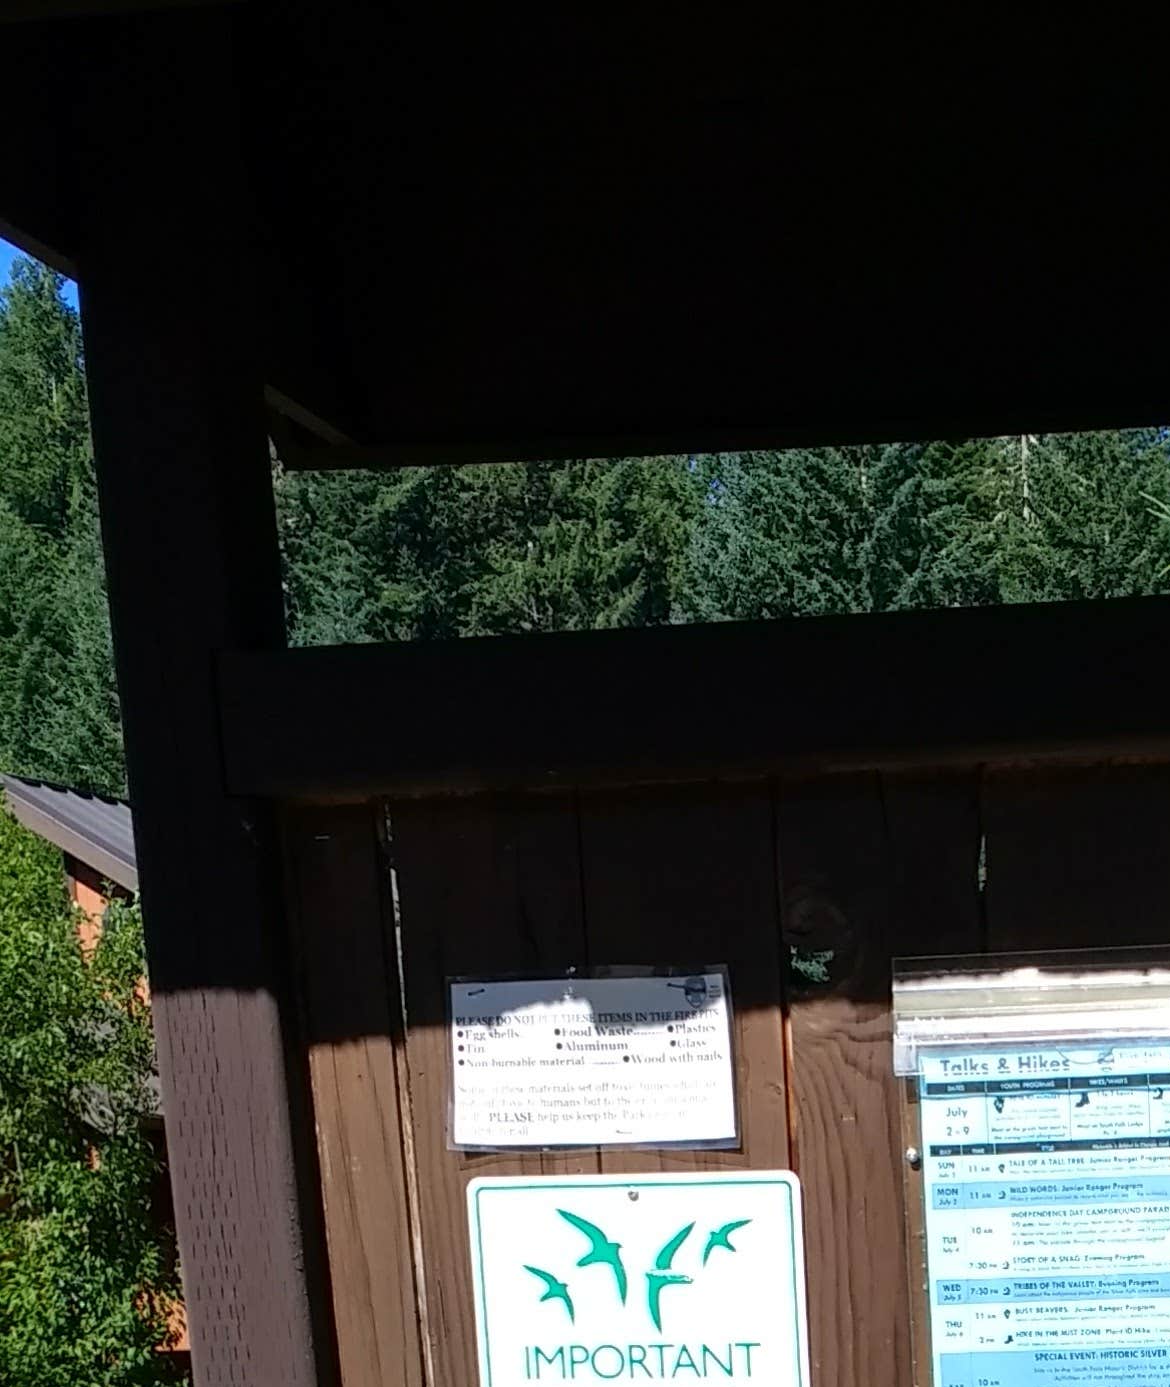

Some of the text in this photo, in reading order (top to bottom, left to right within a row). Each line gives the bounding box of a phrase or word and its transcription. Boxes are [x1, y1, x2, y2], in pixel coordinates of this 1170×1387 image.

[598, 1011, 633, 1024] ITEMS
[635, 1010, 648, 1023] IN
[649, 1010, 674, 1022] THE
[674, 1008, 697, 1021] FIRE
[562, 1025, 592, 1038] Food
[564, 1041, 629, 1052] Aluminum
[539, 1055, 585, 1067] material
[630, 1051, 667, 1065] Wood
[668, 1050, 694, 1064] with
[939, 1054, 1071, 1076] Talks & Hikes
[488, 1111, 535, 1123] PLEASE
[945, 1106, 969, 1119] July
[946, 1126, 970, 1137] 2 9
[937, 1187, 959, 1196] MON
[942, 1283, 962, 1292] WED
[524, 1342, 761, 1380] IMPORTANT
[1035, 1353, 1068, 1361] SPECIAL
[1100, 1350, 1139, 1360] HISTORIC
[1140, 1349, 1168, 1358] SILVER
[978, 1379, 989, 1387] 10
